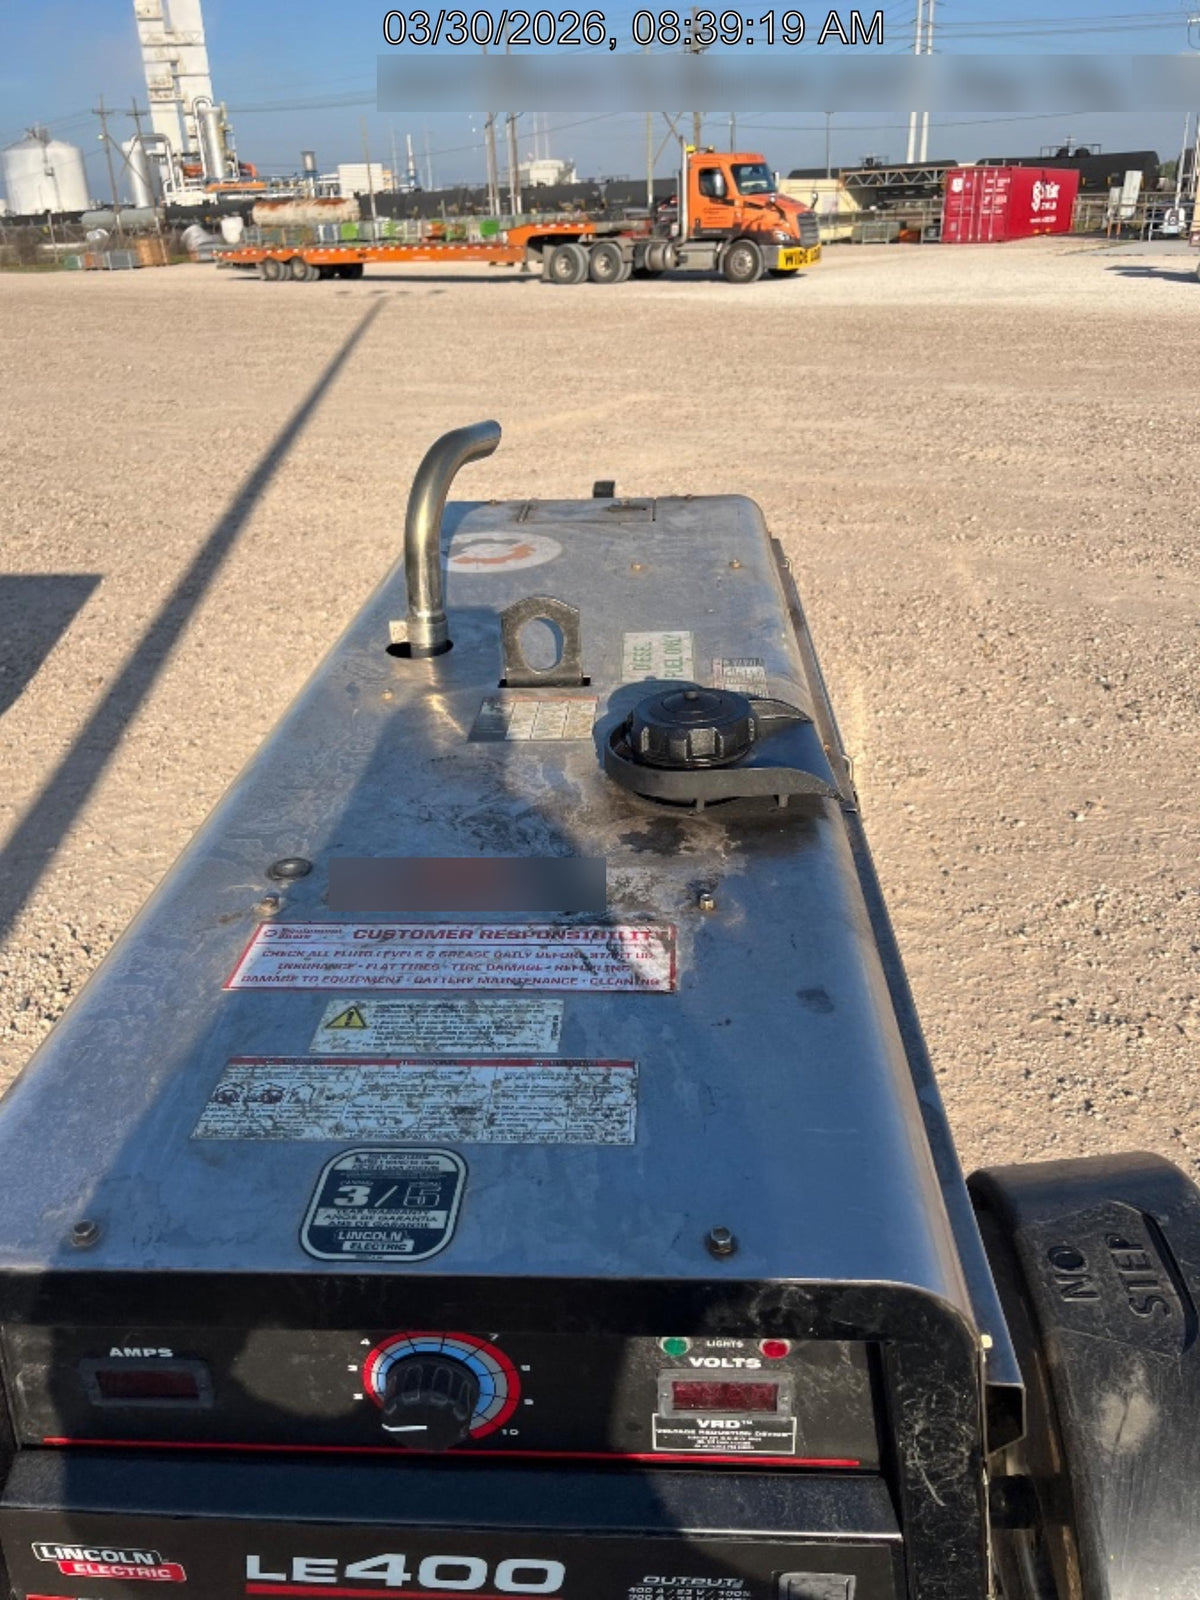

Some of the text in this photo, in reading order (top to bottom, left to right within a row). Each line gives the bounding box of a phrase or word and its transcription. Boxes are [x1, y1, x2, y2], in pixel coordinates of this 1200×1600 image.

[353, 929, 474, 940] CUSTOMER
[262, 950, 306, 958] CHECK
[307, 950, 330, 958] ALL
[438, 950, 490, 959] GREASE
[495, 950, 533, 960] DAILY
[365, 962, 399, 971] FLAT
[400, 962, 441, 971] TIRES
[486, 963, 542, 972] DAMAGE
[241, 975, 299, 984] DAMAGE
[302, 975, 319, 984] TO
[322, 975, 404, 985] EQUIPMENT
[413, 976, 474, 985] BATTERY
[477, 976, 579, 986] MAINTENANCE
[589, 977, 660, 987] CLEANING
[333, 1185, 372, 1207] 3
[337, 1230, 403, 1240] LINCOLN
[348, 1241, 407, 1251] ELECTRIC
[1105, 1232, 1173, 1318] STEP
[360, 1337, 371, 1346] 4
[706, 1339, 744, 1349] LIGHTS
[109, 1346, 174, 1358] AMPS
[688, 1356, 762, 1369] VOLTS
[40, 1545, 154, 1566] LINCOLN
[73, 1562, 172, 1579] ELECTRIC
[246, 1552, 567, 1594] LE400
[642, 1575, 743, 1588] OUTPUT
